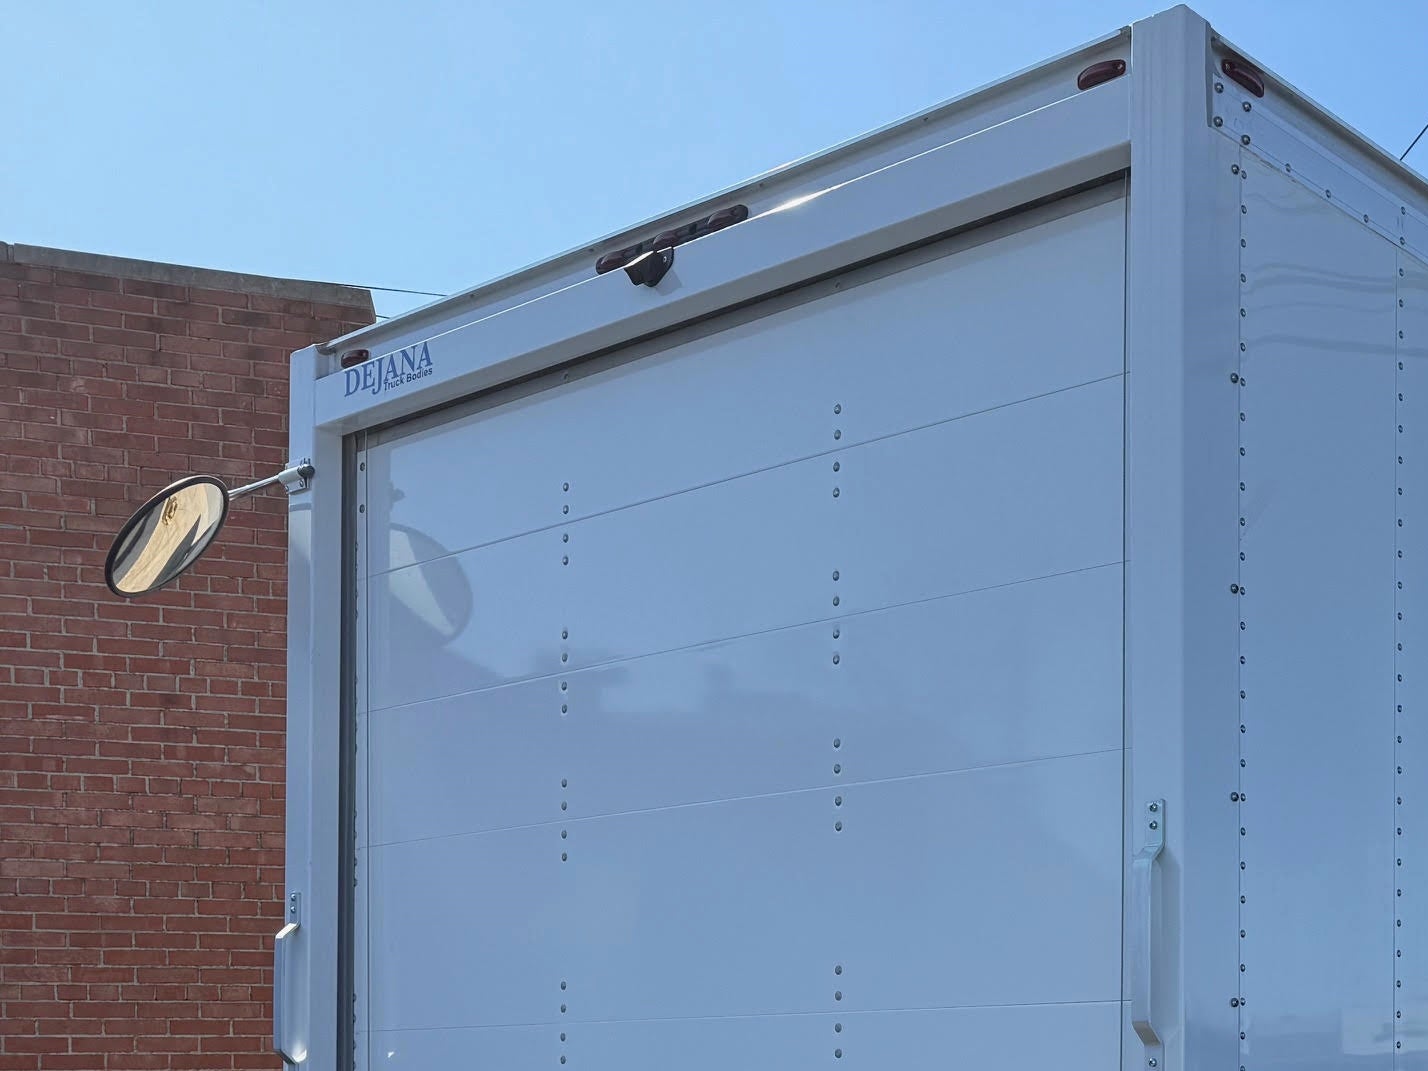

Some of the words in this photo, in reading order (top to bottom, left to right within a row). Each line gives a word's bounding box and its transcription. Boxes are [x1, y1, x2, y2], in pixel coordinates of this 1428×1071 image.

[344, 341, 433, 397] DEJANA
[384, 376, 404, 391] Truck
[406, 368, 433, 383] Bodies
